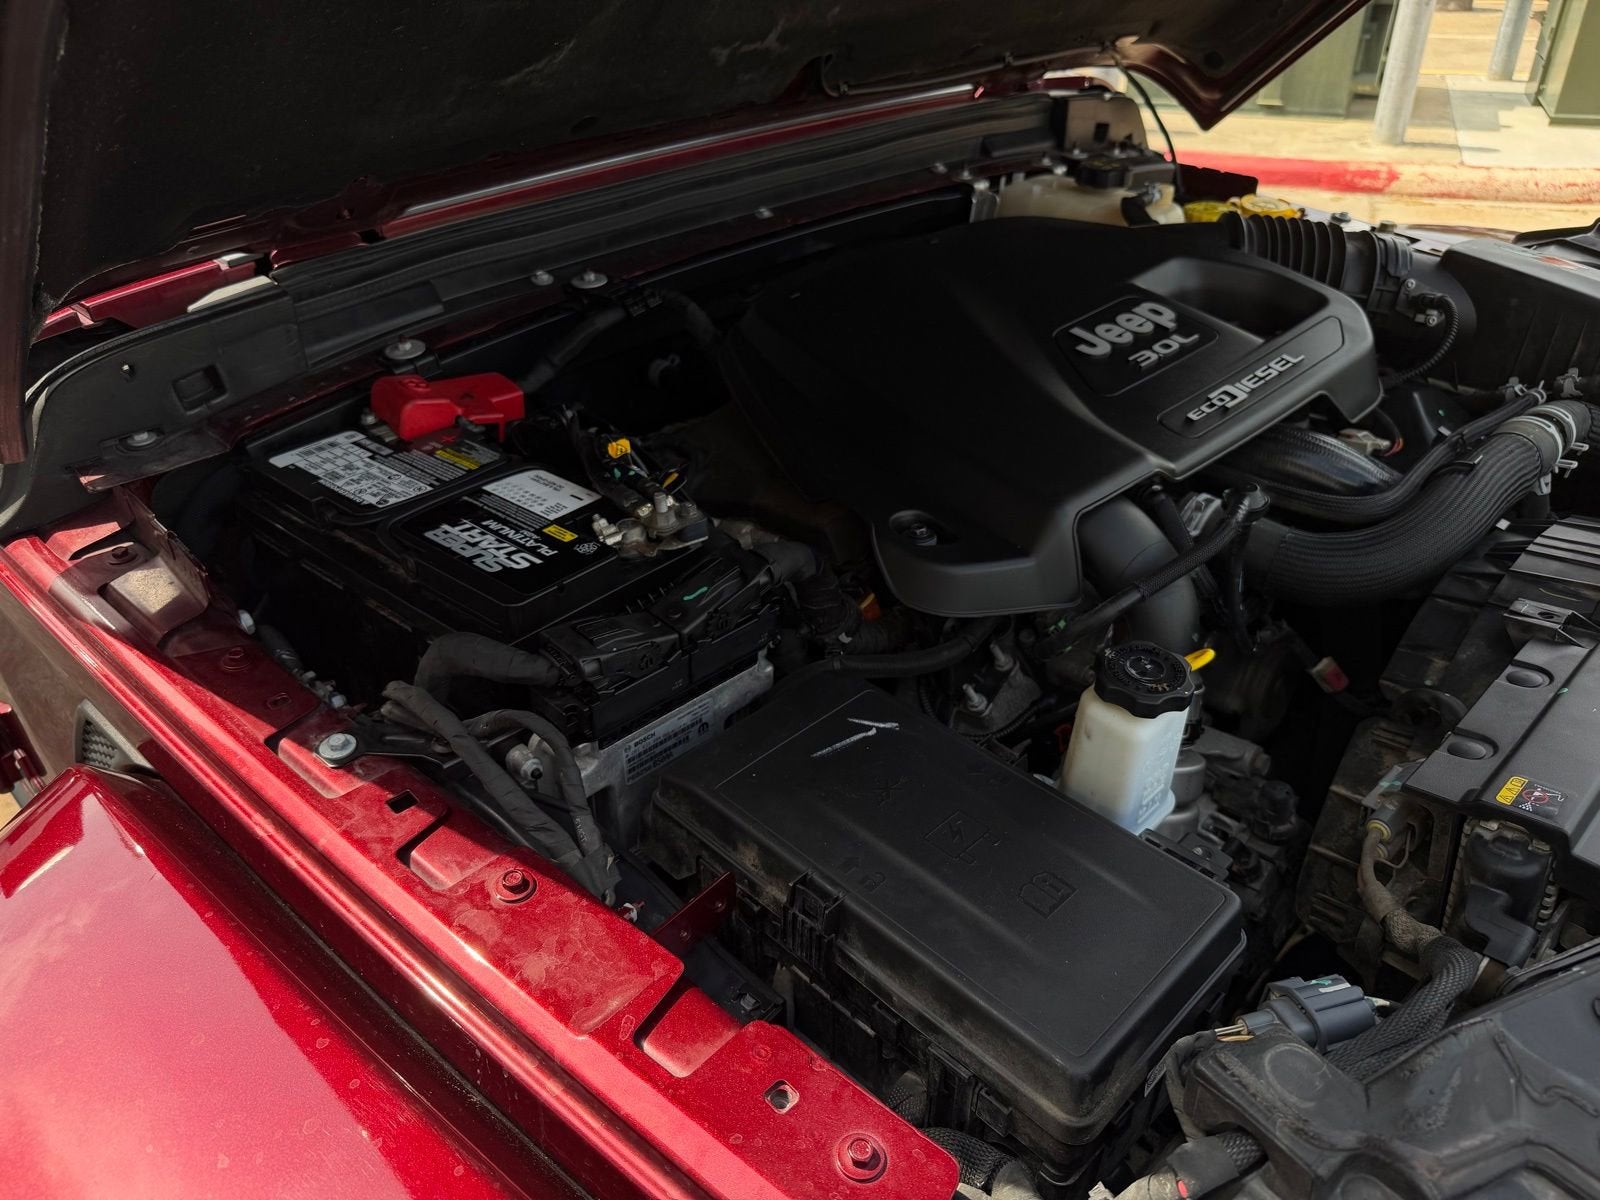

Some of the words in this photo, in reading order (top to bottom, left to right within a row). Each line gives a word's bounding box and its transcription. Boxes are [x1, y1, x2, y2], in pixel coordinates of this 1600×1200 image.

[1068, 302, 1178, 358] Jeep
[1128, 333, 1200, 368] 3.0L
[424, 528, 503, 572] SUPER
[440, 524, 544, 569] START
[481, 520, 558, 556] PLATINUM
[634, 732, 656, 747] BOSCH
